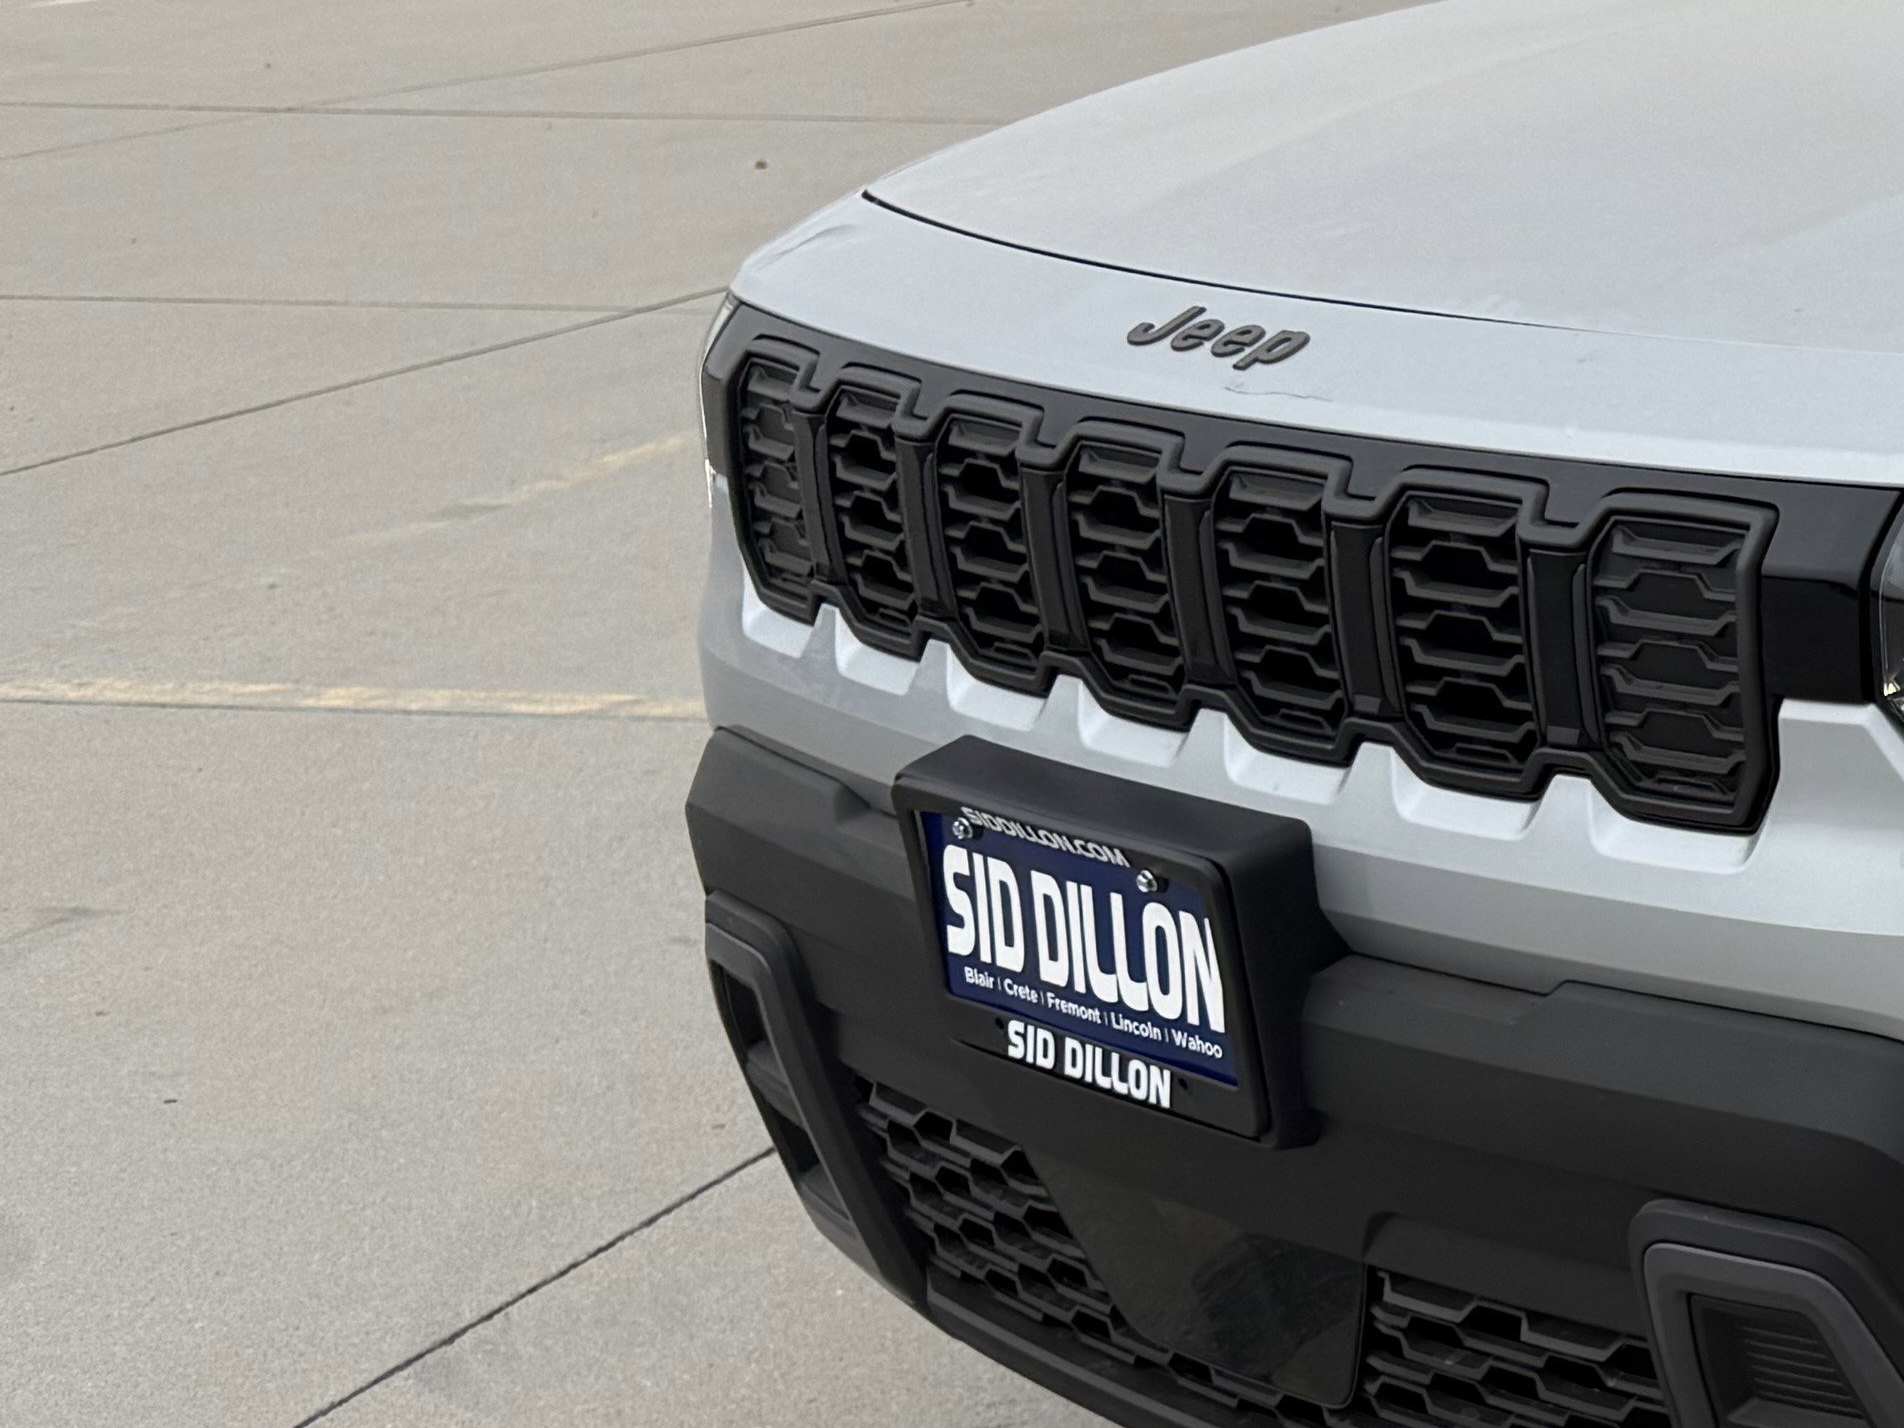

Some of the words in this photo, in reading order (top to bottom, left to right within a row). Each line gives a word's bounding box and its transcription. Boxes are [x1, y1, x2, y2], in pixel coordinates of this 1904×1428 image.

[1126, 305, 1311, 372] Jeep
[960, 806, 1131, 868] SIDDILLON.COM
[943, 844, 1026, 973] SID
[1030, 870, 1226, 1034] DILLON
[964, 966, 995, 990] Blair
[1004, 980, 1039, 1004] Crete
[1047, 992, 1102, 1025] Fremont
[1110, 1013, 1162, 1043] Lincoln
[1171, 1030, 1223, 1059] Wahoo
[1007, 1019, 1056, 1070] SID
[1064, 1037, 1171, 1110] DILLON
